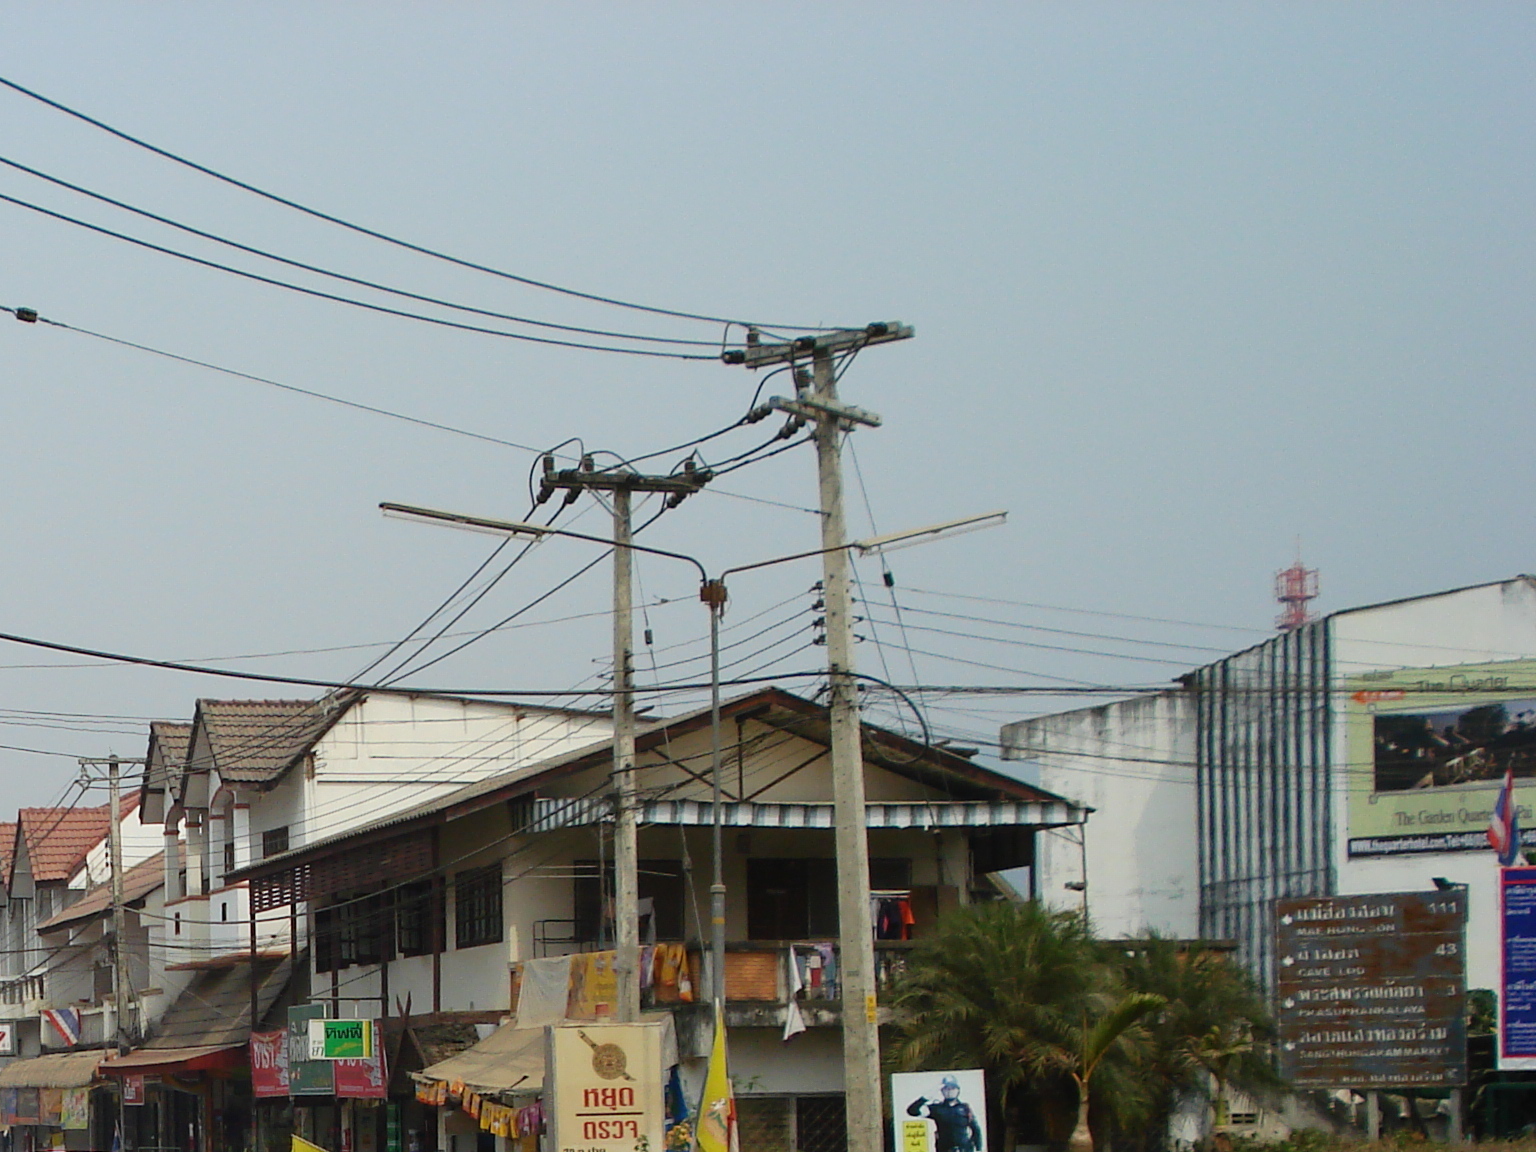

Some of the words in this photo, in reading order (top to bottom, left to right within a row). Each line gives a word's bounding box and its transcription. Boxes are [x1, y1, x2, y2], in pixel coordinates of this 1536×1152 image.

[1395, 811, 1415, 826] The
[1418, 808, 1455, 825] Garden
[1428, 902, 1457, 914] 111
[1297, 927, 1322, 936] MAE
[1435, 942, 1457, 956] 43
[1298, 966, 1331, 977] CAVE
[1446, 985, 1456, 997] 3
[583, 1087, 635, 1111] หยุด
[583, 1120, 639, 1140] ตรวจ
